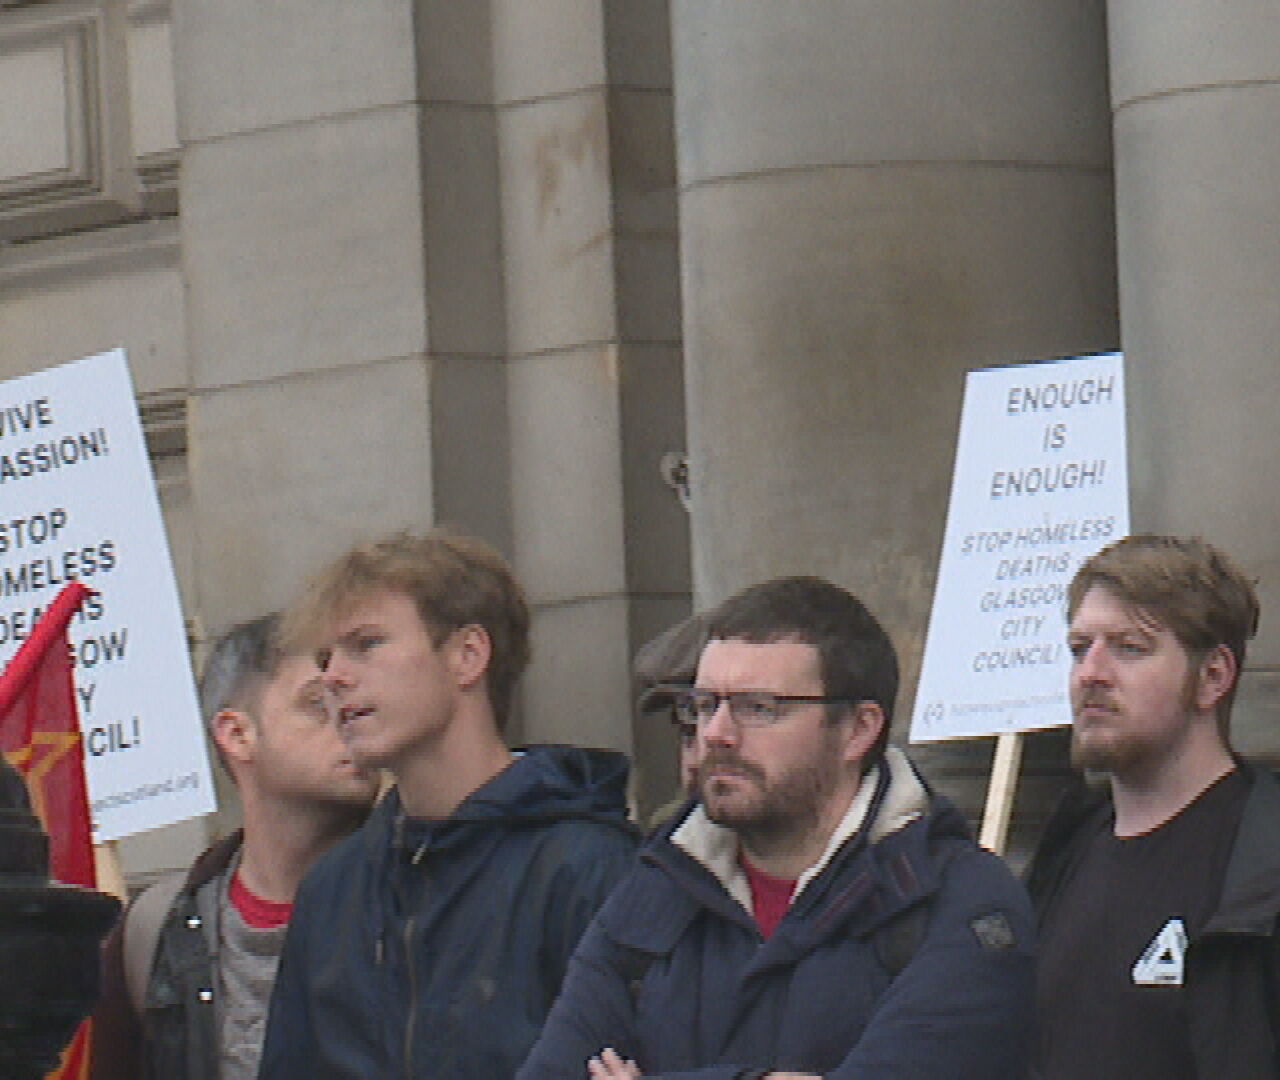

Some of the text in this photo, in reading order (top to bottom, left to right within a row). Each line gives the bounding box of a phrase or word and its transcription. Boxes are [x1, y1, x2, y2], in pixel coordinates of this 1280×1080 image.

[1006, 376, 1114, 416] ENOUGH
[1043, 424, 1067, 452] IS
[989, 459, 1106, 500] ENOUGH!
[961, 516, 1116, 556] STOP HOMELESS
[0, 540, 116, 598] MELESS
[996, 552, 1070, 580] DEATHS
[1000, 616, 1046, 640] CITY
[973, 644, 1063, 673] COUNCIL!
